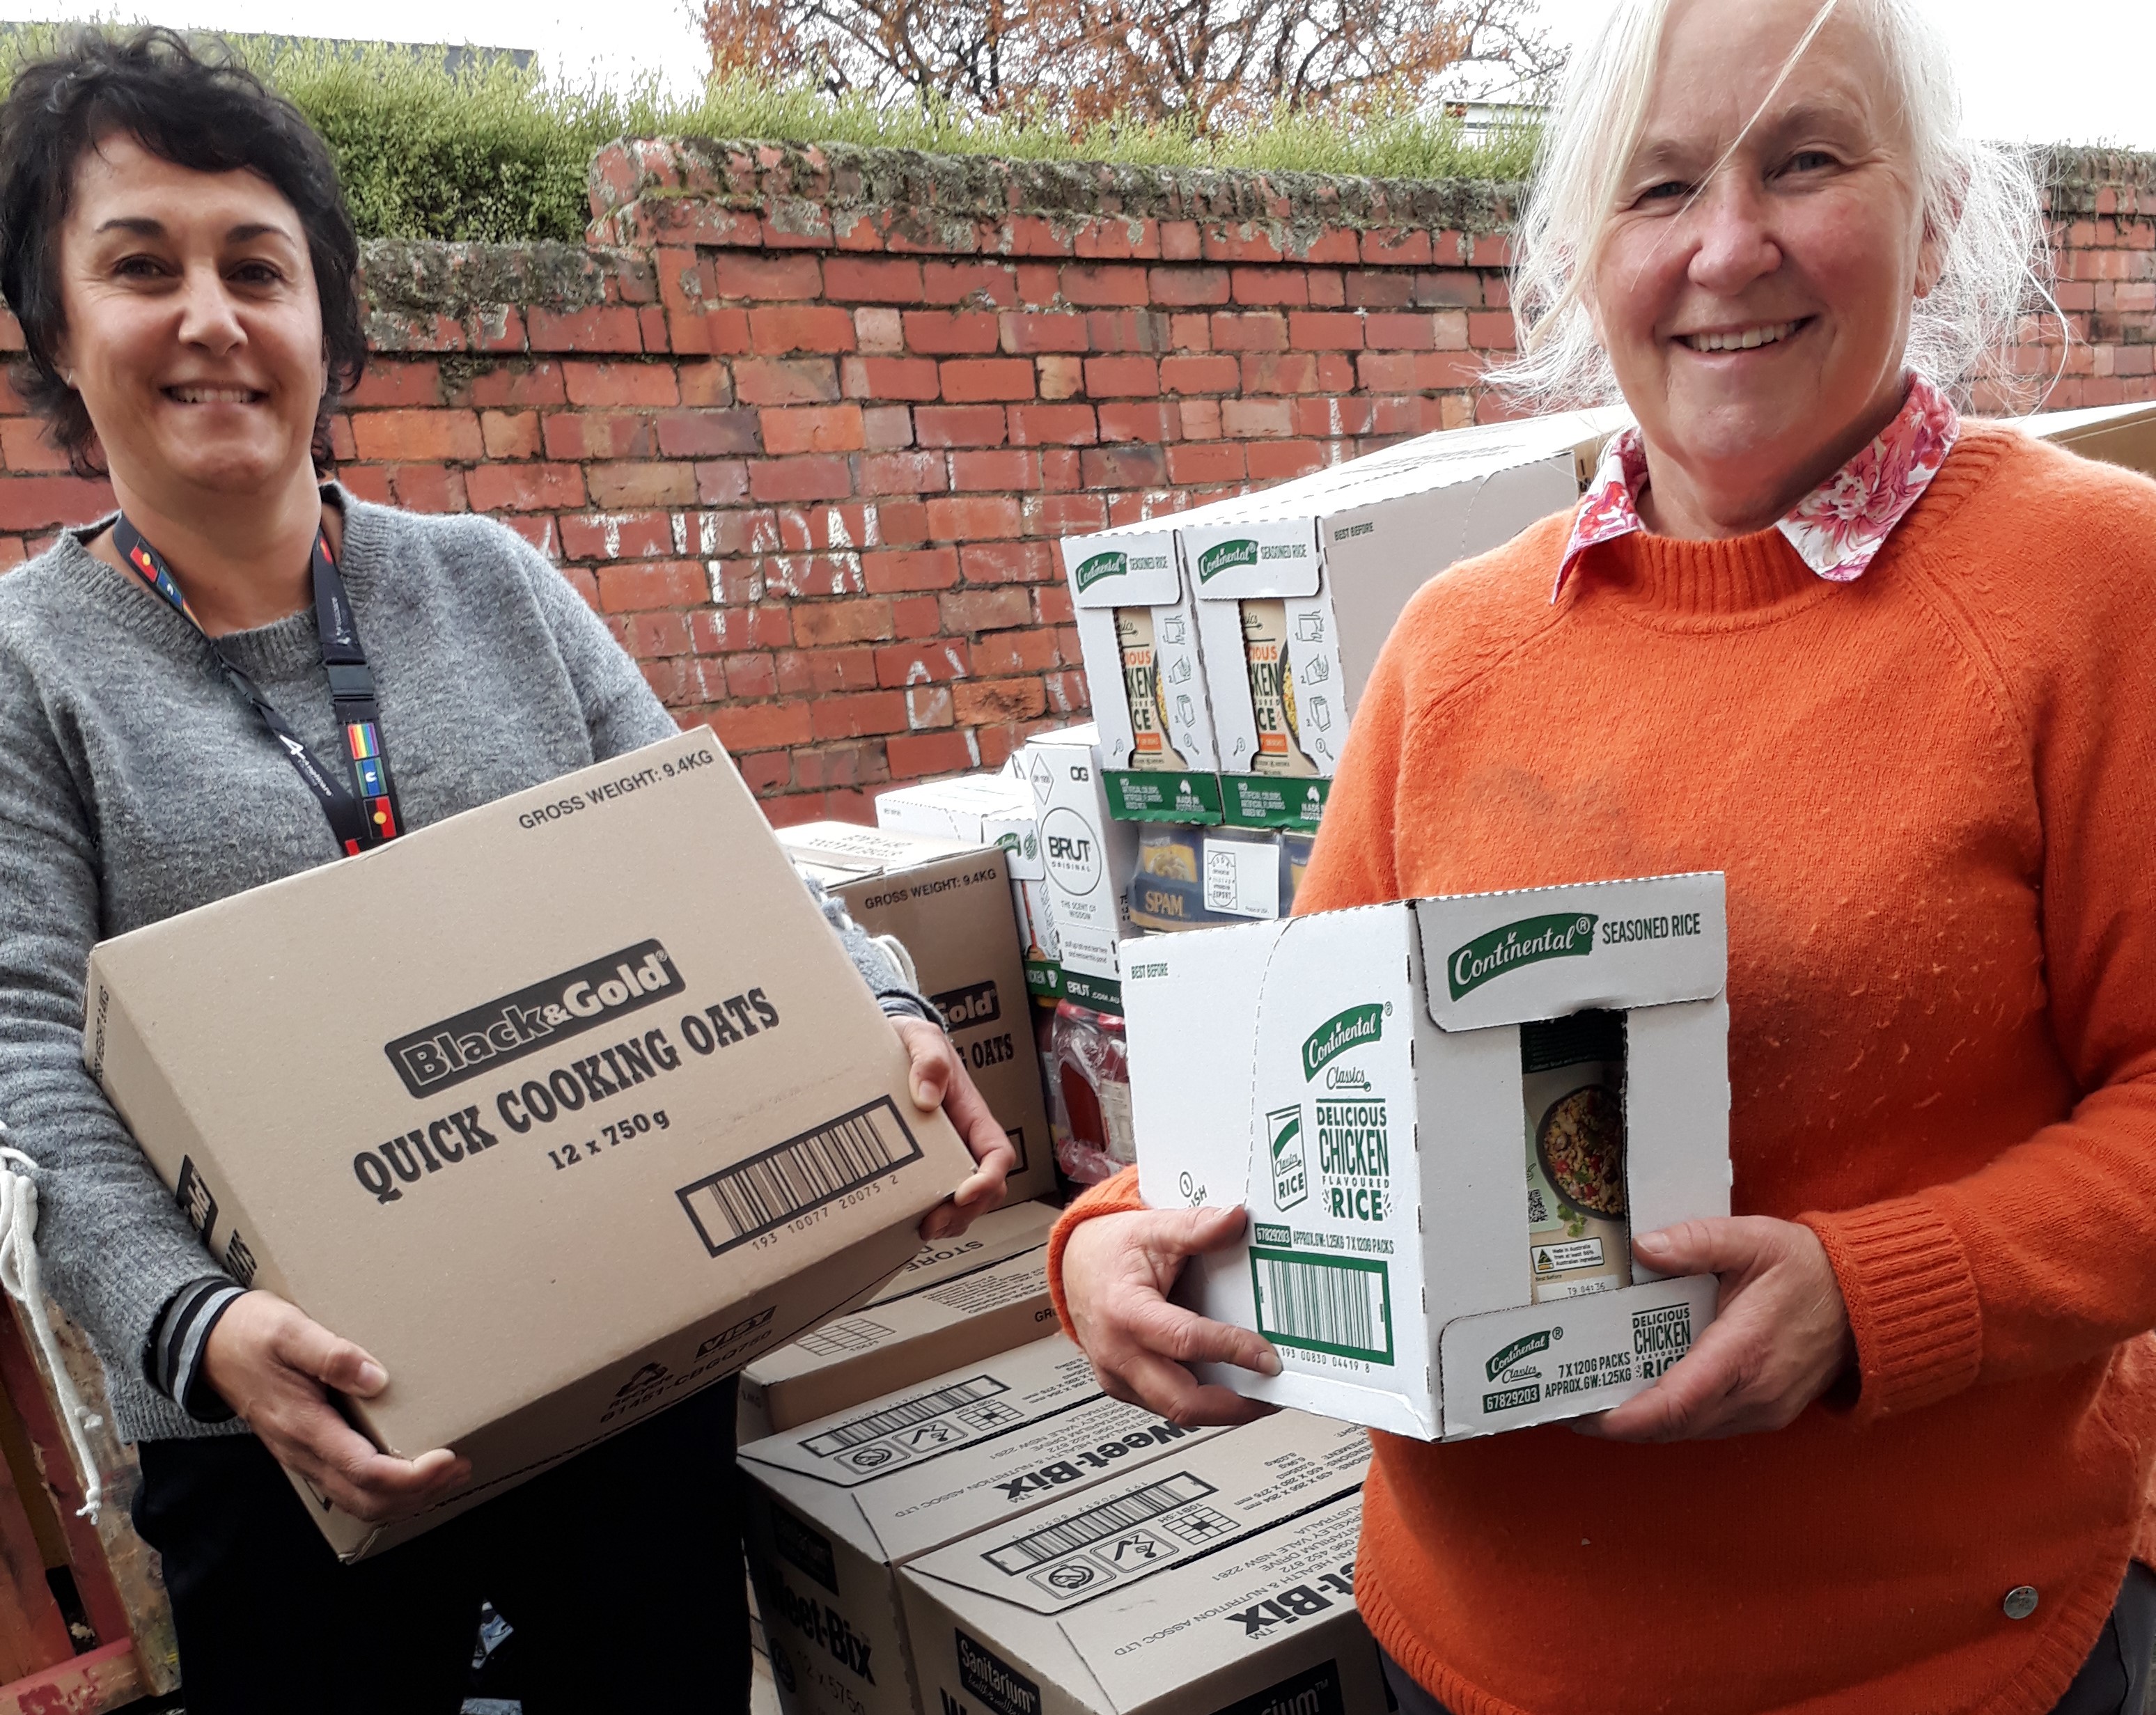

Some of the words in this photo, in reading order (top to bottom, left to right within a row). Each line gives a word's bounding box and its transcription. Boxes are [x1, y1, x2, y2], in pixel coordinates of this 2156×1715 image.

[1334, 528, 1349, 541] BEST
[1350, 522, 1374, 538] BEFORE
[1078, 559, 1120, 586] Continental
[1201, 546, 1251, 577] Continental
[519, 795, 586, 829] GROSS
[586, 769, 662, 805] WEIGHT:
[662, 749, 714, 777] 9.4KG
[1048, 836, 1089, 861] BRUT
[865, 889, 907, 909] GROSS
[911, 877, 961, 898] WEIGHT:
[963, 868, 997, 886] 9.4KG
[1146, 891, 1183, 917] SPAM
[1455, 925, 1574, 985] Continental
[1602, 917, 1669, 944] SEASONED
[1671, 913, 1701, 937] RICE
[1131, 964, 1146, 979] BEST
[1147, 962, 1169, 978] BEFORE
[403, 950, 671, 1087] Black&Gold
[971, 1033, 1013, 1068] OATS
[1309, 1012, 1376, 1068] Continental
[1327, 1067, 1365, 1089] Classics
[353, 1105, 499, 1205] QUICK
[496, 1028, 682, 1134] COOKING
[680, 987, 779, 1056] OATS
[1316, 1106, 1386, 1127] DELICIOUS
[548, 1145, 581, 1171] 12
[586, 1140, 602, 1156] x
[1319, 1129, 1389, 1177] CHICKEN
[1278, 1171, 1304, 1199] RICE
[1322, 1175, 1389, 1189] FLAVOURED
[751, 1232, 778, 1251] 193
[787, 1207, 829, 1235] 10077
[838, 1183, 881, 1209] 20075
[889, 1174, 898, 1185] 2
[1331, 1188, 1383, 1221] RICE
[906, 1241, 984, 1272] STORE
[1373, 1239, 1394, 1254] PACKS
[1632, 1308, 1689, 1329] DELICIOUS
[1634, 1319, 1691, 1354] CHICKEN
[1282, 1347, 1295, 1358] 193
[1301, 1351, 1327, 1364] 00830
[1332, 1357, 1359, 1370] 04419
[1365, 1363, 1370, 1373] 8
[1491, 1333, 1545, 1374] Continental
[1559, 1365, 1564, 1379] 7
[1600, 1352, 1630, 1370] PACKS
[1502, 1365, 1536, 1384] Classics
[1487, 1386, 1538, 1411] 67829203
[992, 1420, 1201, 1500] Weet-Bix
[1047, 1441, 1091, 1460] HEALTH
[894, 1505, 919, 1517] LTD
[1233, 1496, 1252, 1506] mm
[1243, 1501, 1262, 1511] mm
[1275, 1537, 1309, 1555] VALE
[1299, 1524, 1363, 1554] NITARIUM
[1329, 1537, 1353, 1551] 096
[1242, 1551, 1275, 1569] NSW
[1258, 1551, 1299, 1572] DRIVE
[1278, 1560, 1304, 1575] 872
[1303, 1548, 1329, 1563] 452
[1211, 1565, 1243, 1582] 2261
[1280, 1559, 1330, 1584] HEALTH
[1266, 1581, 1279, 1590] &
[1194, 1588, 1265, 1622] NUTRITION
[1142, 1619, 1191, 1644] ASSOC
[1249, 1626, 1279, 1640] TM
[1113, 1640, 1141, 1657] LTD
[960, 1639, 1031, 1714] Sanitarium
